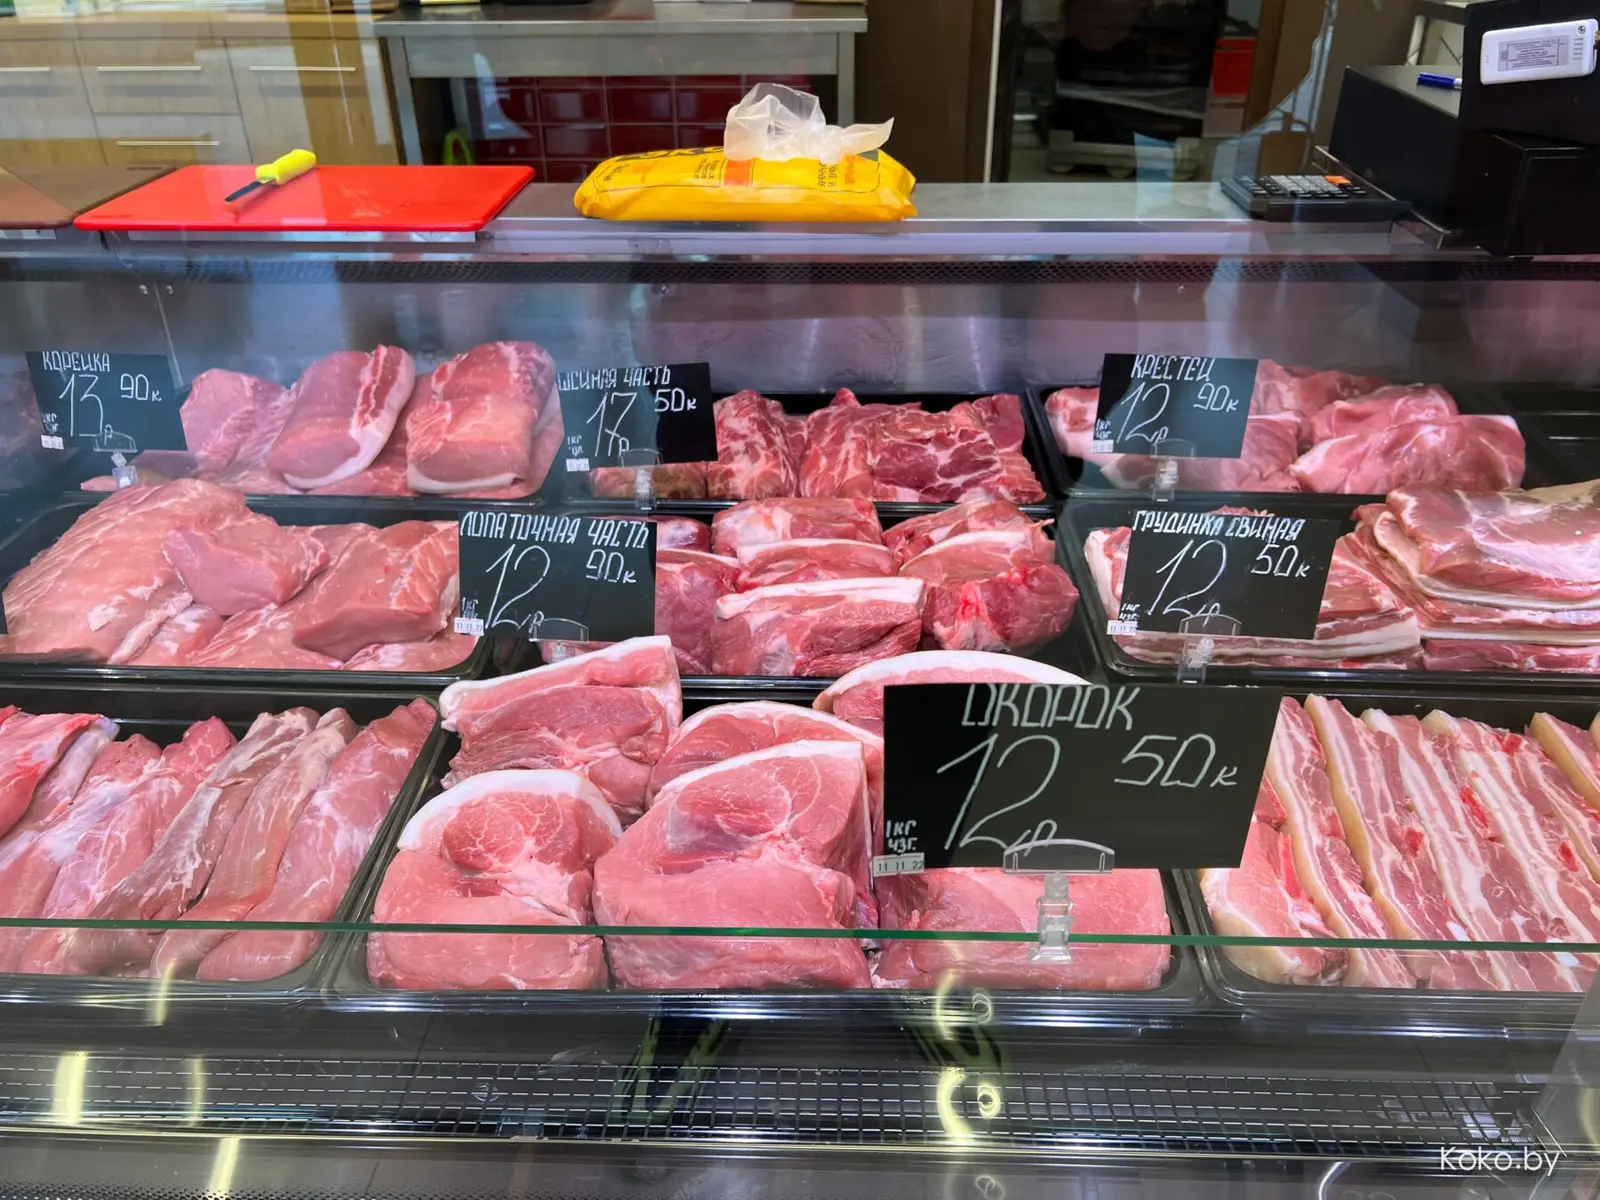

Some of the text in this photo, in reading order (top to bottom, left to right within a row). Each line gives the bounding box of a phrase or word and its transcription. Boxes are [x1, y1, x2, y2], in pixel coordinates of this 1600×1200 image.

[623, 365, 671, 387] ЧАСТЬ
[1131, 354, 1216, 382] КРЕСТЕЦ
[459, 511, 650, 549] ЛОПАТОЧНАЯ ЧАСТЬ
[1132, 510, 1306, 543] ГРУДИНКА СВИНАЯ
[961, 683, 1140, 730] ОКОРОК
